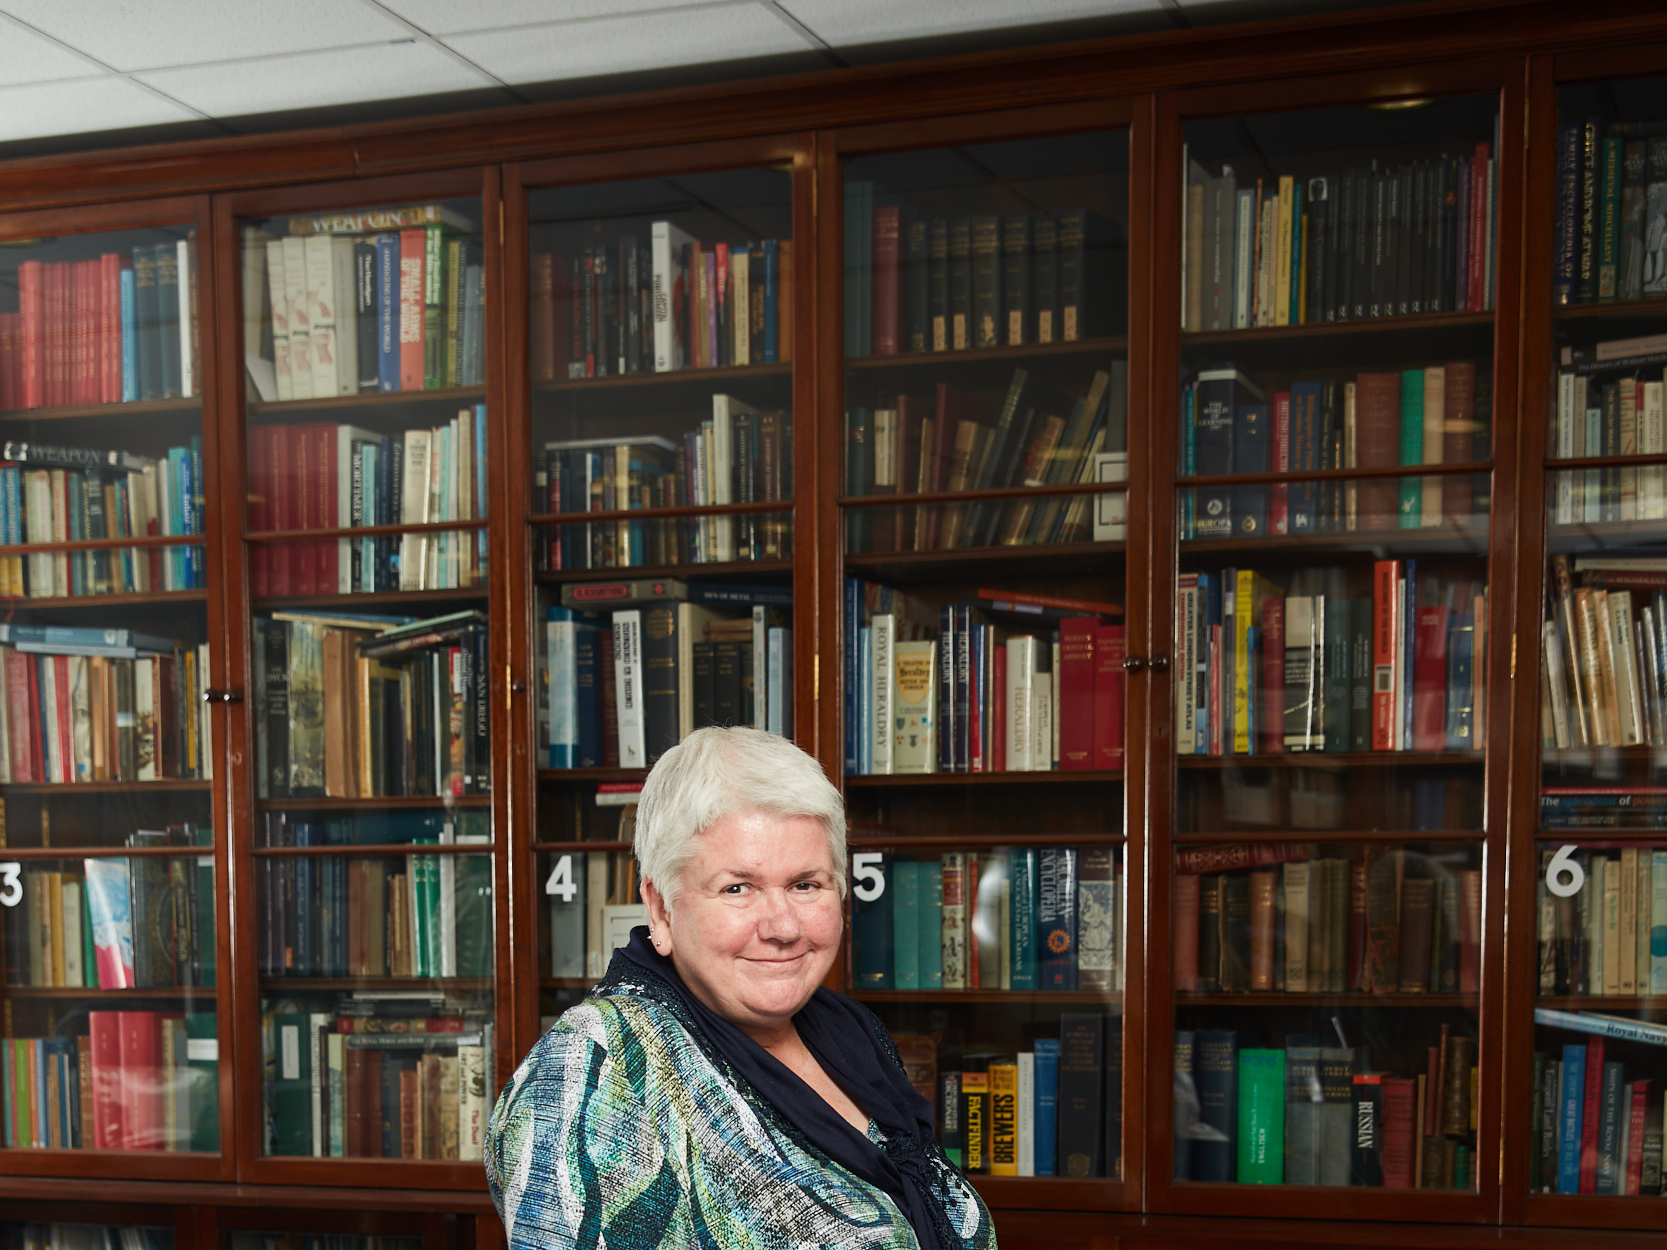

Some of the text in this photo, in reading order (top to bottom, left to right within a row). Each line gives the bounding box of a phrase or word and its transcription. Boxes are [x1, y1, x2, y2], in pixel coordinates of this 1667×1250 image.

[1583, 171, 1593, 198] AND
[1606, 152, 1614, 199] MEDIEVAL
[312, 210, 402, 233] WEAPON
[1564, 129, 1578, 278] FAMILY ENCYCLOPEDIA OF
[1604, 204, 1612, 263] MISCELLANY
[382, 247, 392, 295] HANDGUNS
[1581, 254, 1590, 279] WAR
[400, 258, 410, 343] OF THE WORLD
[410, 258, 421, 342] SMALL ARMS
[382, 322, 392, 353] WORLD
[1198, 419, 1233, 427] LEARNING
[1279, 400, 1289, 433] BRITISH
[1295, 406, 1304, 460] London History
[1304, 395, 1315, 440] Bibliography
[31, 446, 101, 464] WEAPON
[353, 454, 362, 520] MORTIMER
[1382, 608, 1388, 616] OF
[942, 631, 950, 684] HERALDRY
[958, 631, 966, 684] HERALDRY
[478, 674, 486, 736] SAN DIEGO
[878, 627, 886, 748] ROYAL HERALDRY
[1014, 686, 1024, 754] HERALDRY
[1541, 796, 1630, 808] The splendour of
[0, 862, 23, 908] 3
[546, 855, 577, 902] 4
[852, 852, 886, 902] 5
[1041, 849, 1056, 922] ENCYCLOPEDIA
[1546, 845, 1584, 897] 6
[1606, 1023, 1667, 1045] Royal Navy
[1242, 1055, 1276, 1068] PONS
[1567, 1099, 1576, 1117] GREAT
[1568, 1074, 1577, 1097] SEVENTY
[472, 1110, 480, 1124] The
[968, 1096, 982, 1169] FACTFINDER
[993, 1094, 1014, 1163] BREWERS
[1358, 1101, 1373, 1148] RUSSIAN
[1542, 1069, 1555, 1157] European Land Battles
[1566, 1118, 1575, 1141] BATTLES
[1602, 1068, 1617, 1176] SHIPS OF THE ROYAL NAVY
[1564, 1163, 1573, 1175] TIME
